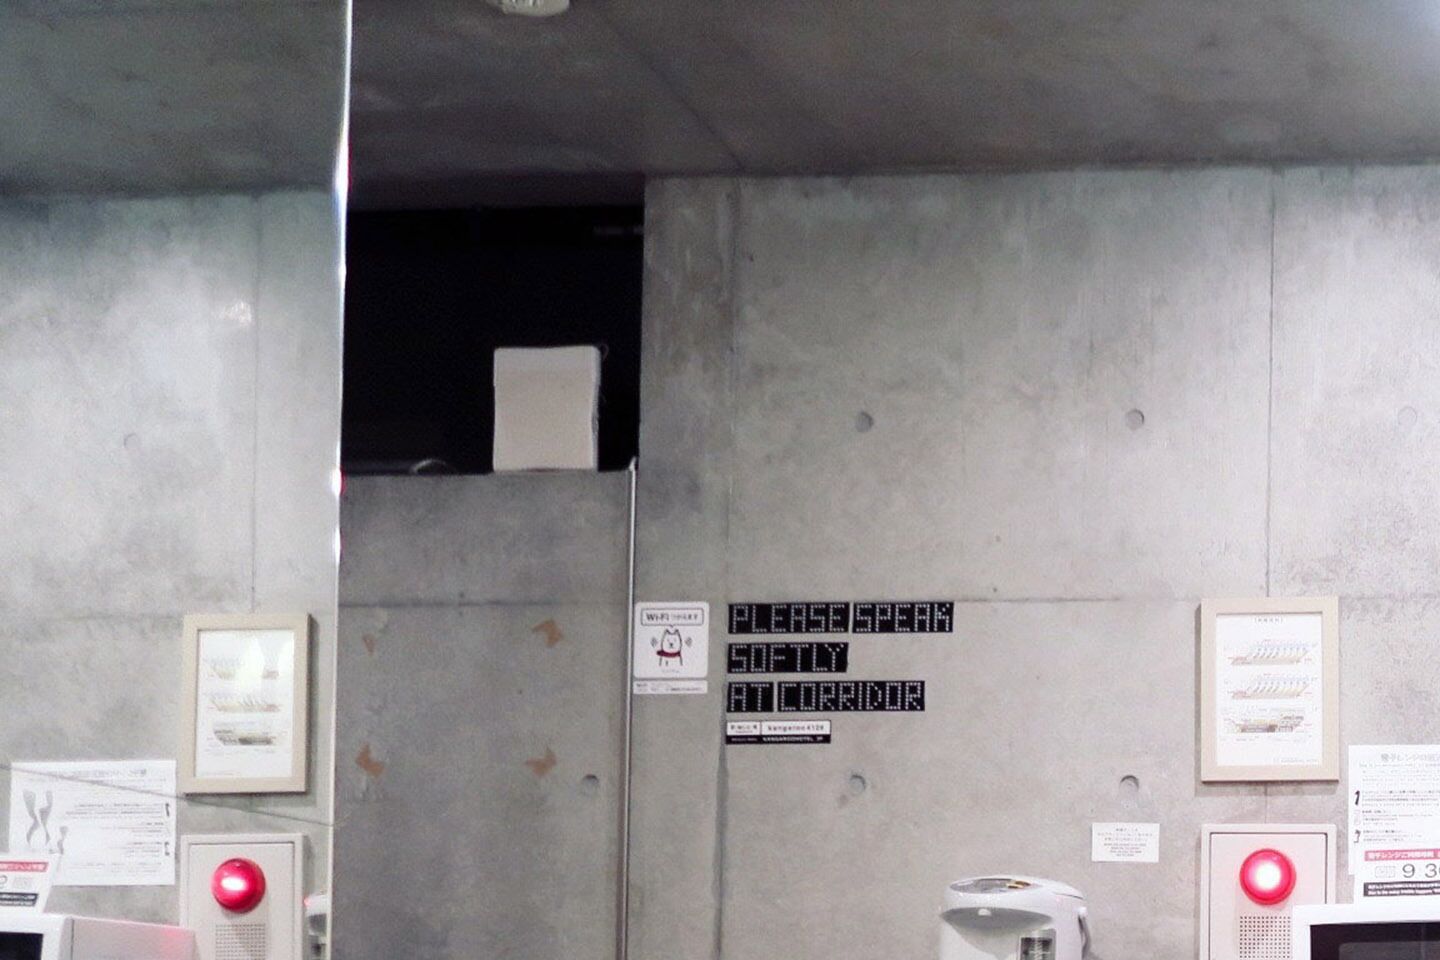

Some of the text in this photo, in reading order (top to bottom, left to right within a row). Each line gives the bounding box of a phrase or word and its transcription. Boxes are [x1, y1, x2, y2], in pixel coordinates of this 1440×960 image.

[732, 603, 950, 632] PLEASE SPEAK
[731, 643, 845, 671] SOFTLY
[730, 683, 770, 711] AT
[780, 682, 922, 710] CORRIDOR
